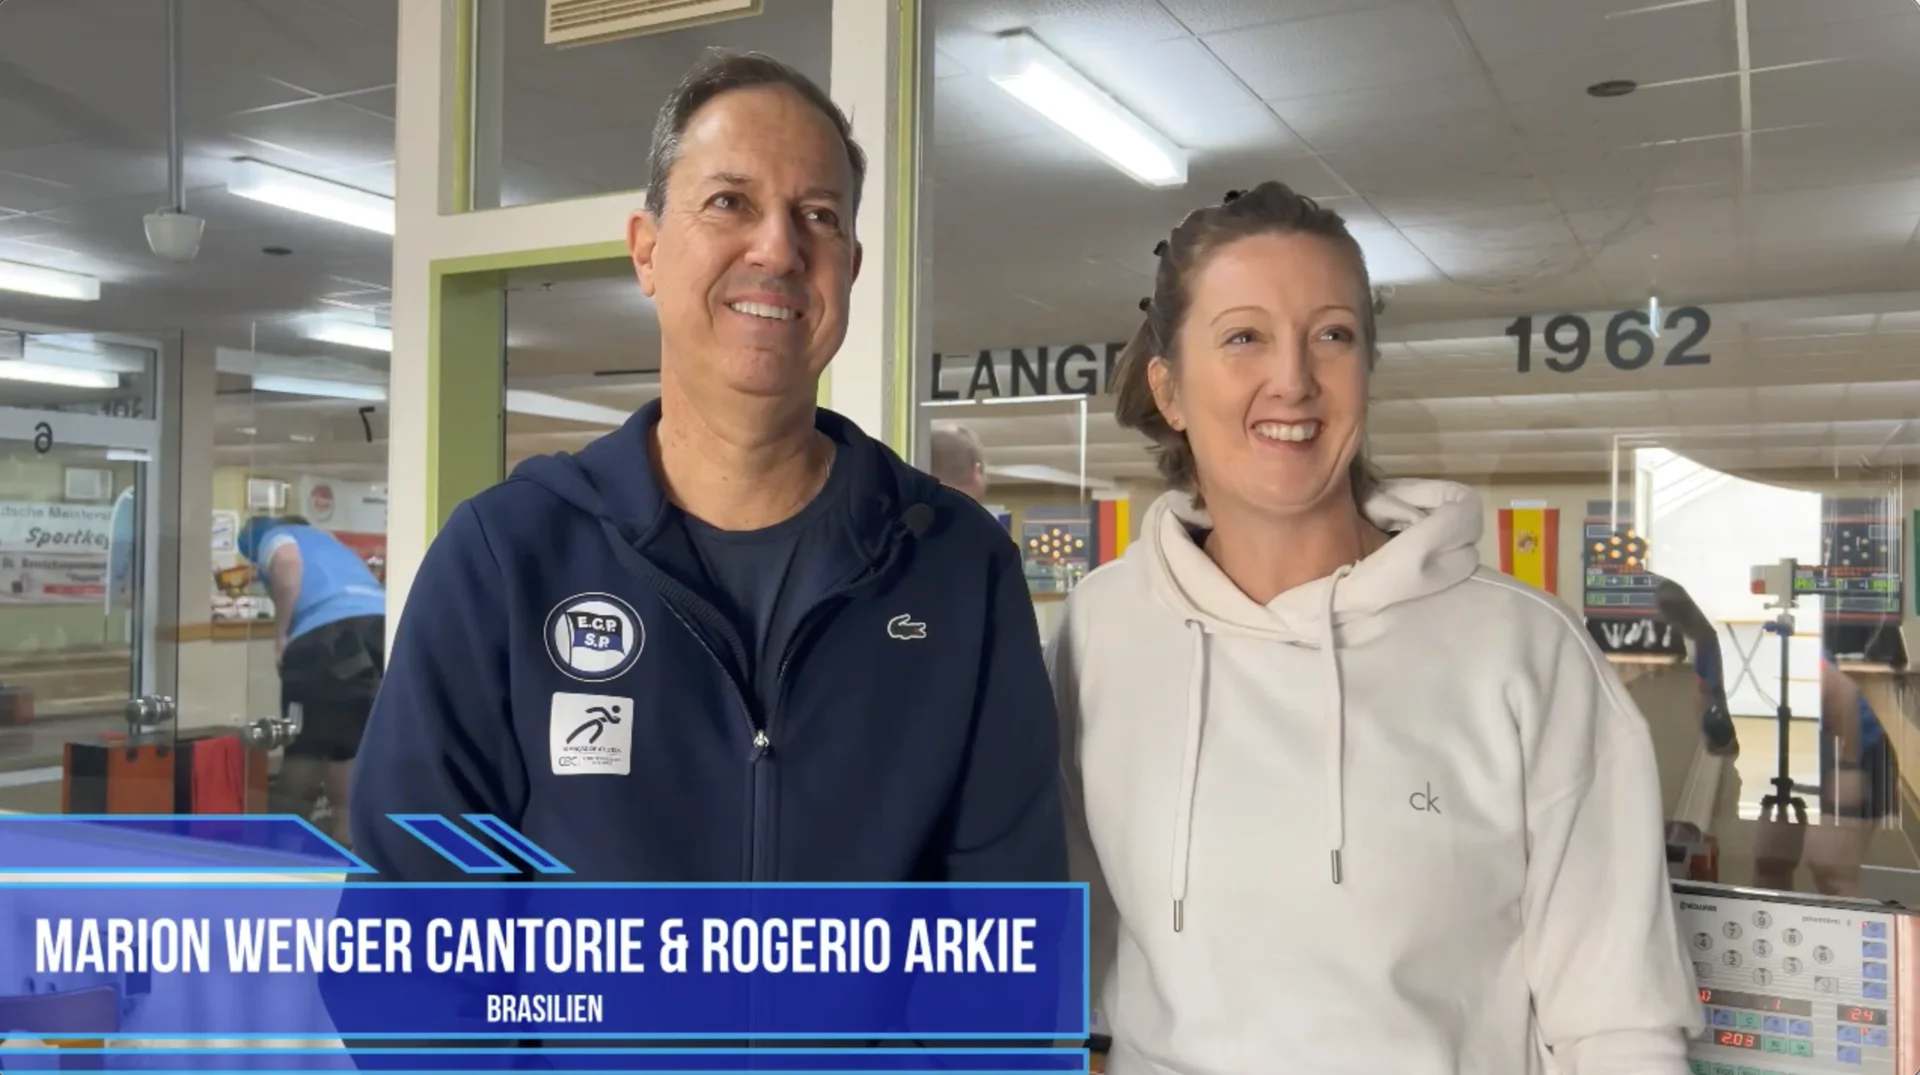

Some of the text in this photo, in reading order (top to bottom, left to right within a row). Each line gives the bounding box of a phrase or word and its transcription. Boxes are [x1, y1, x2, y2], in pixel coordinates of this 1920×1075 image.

[1505, 306, 1712, 373] 1962
[577, 616, 617, 632] E.C.P.
[584, 633, 610, 648] S.P.
[1409, 781, 1441, 814] ck
[1851, 1008, 1874, 1021] 24
